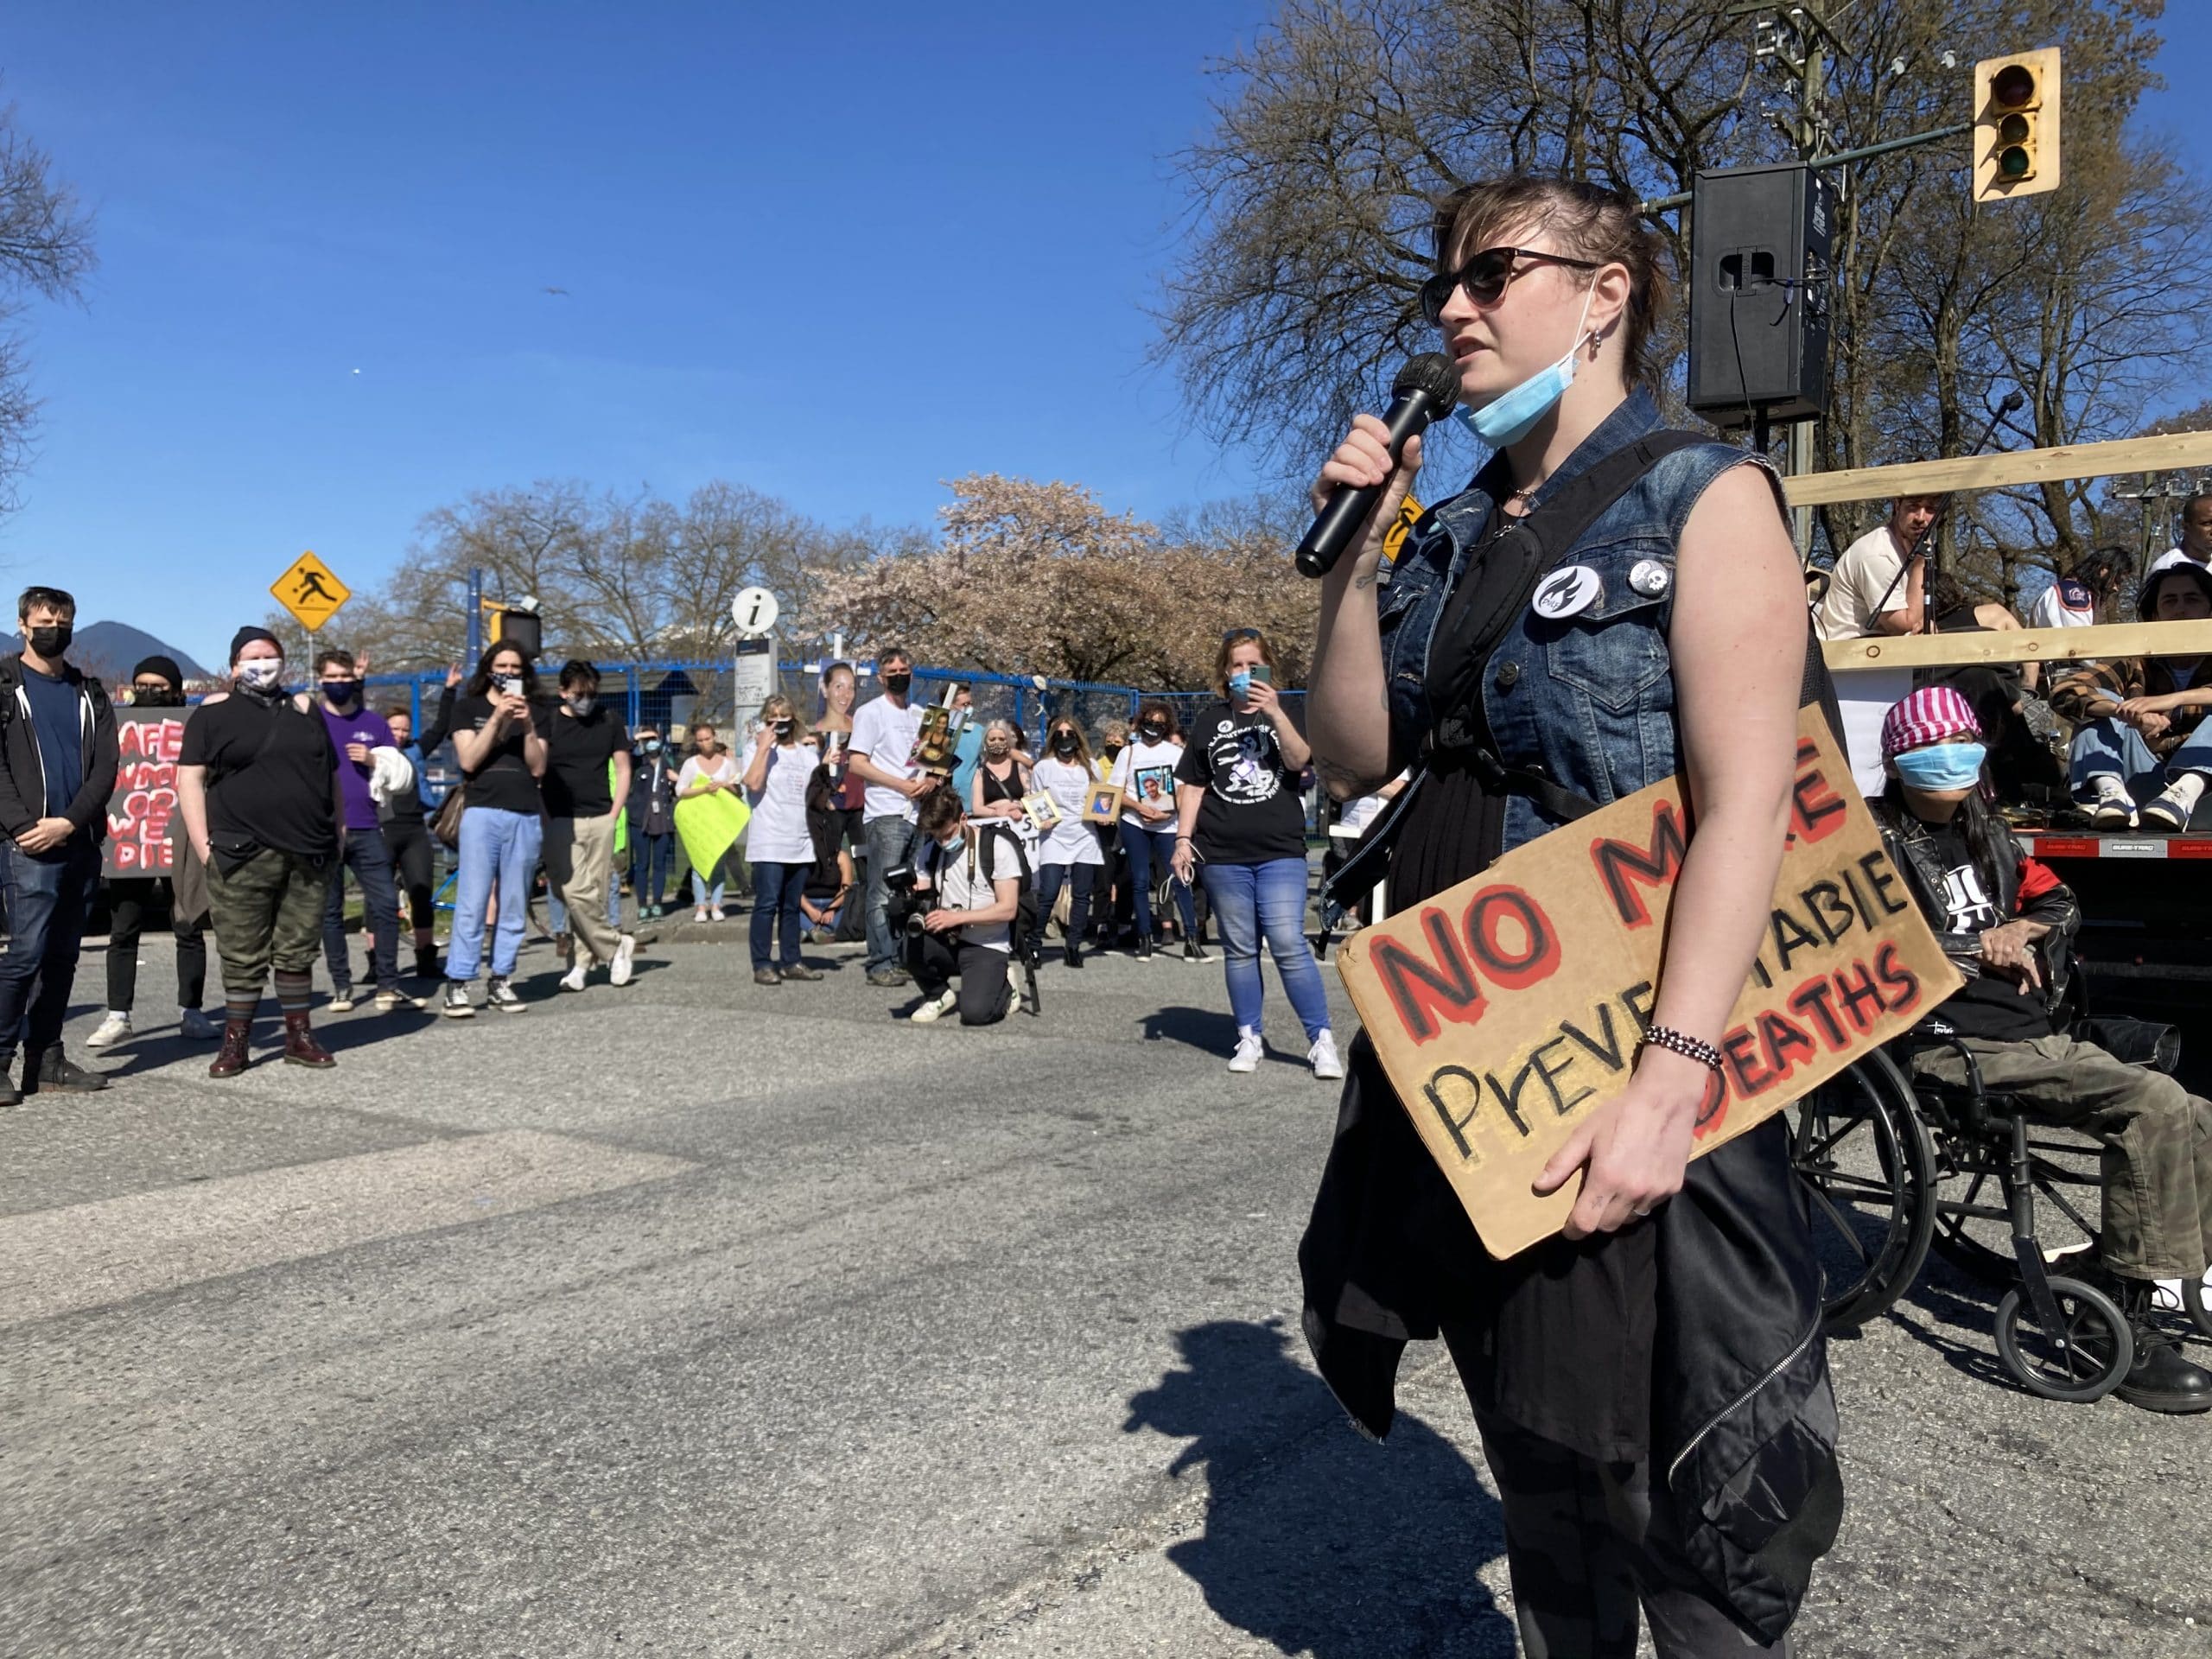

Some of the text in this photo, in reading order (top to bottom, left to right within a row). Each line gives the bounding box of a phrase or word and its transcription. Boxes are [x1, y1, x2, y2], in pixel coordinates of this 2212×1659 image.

[118, 719, 183, 761] AFE
[124, 788, 178, 817] OR
[108, 814, 168, 844] WE
[114, 837, 173, 869] DIE
[1370, 736, 1847, 1046] NO ME
